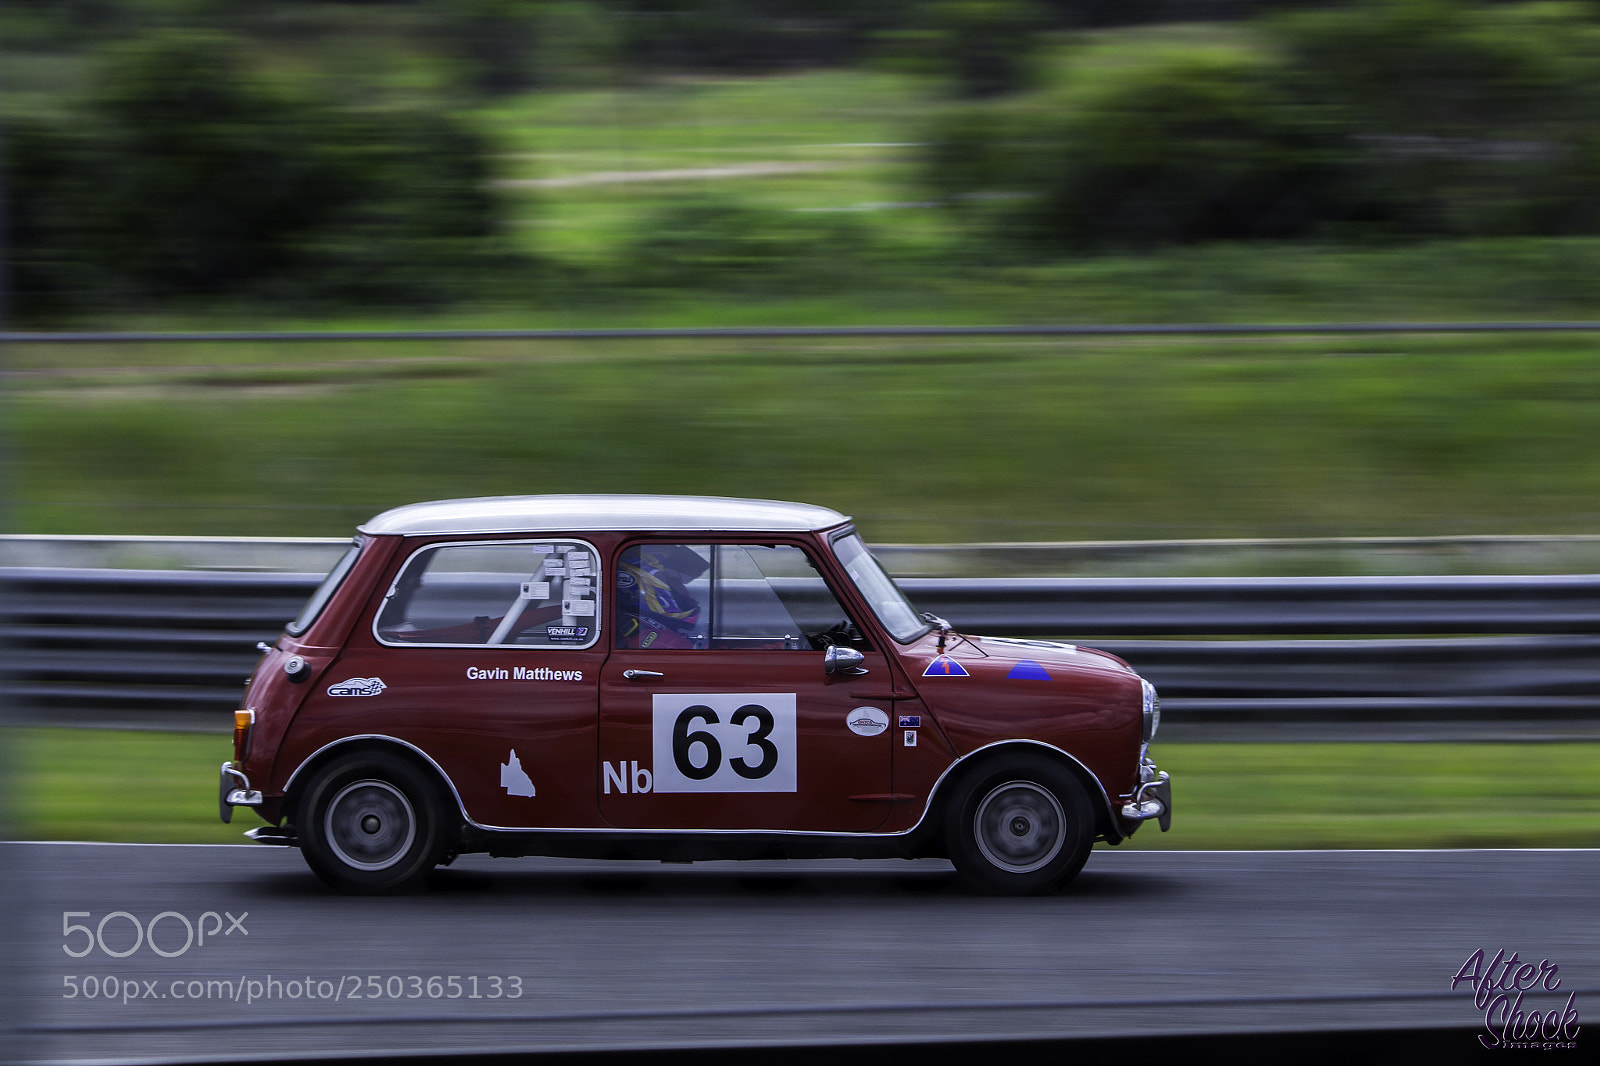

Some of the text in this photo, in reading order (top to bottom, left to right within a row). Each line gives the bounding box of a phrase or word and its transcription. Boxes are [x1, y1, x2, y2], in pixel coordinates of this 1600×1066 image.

[547, 627, 576, 635] VENHILL
[466, 666, 583, 681] Gavin Matthews
[602, 703, 779, 795] Nb 63
